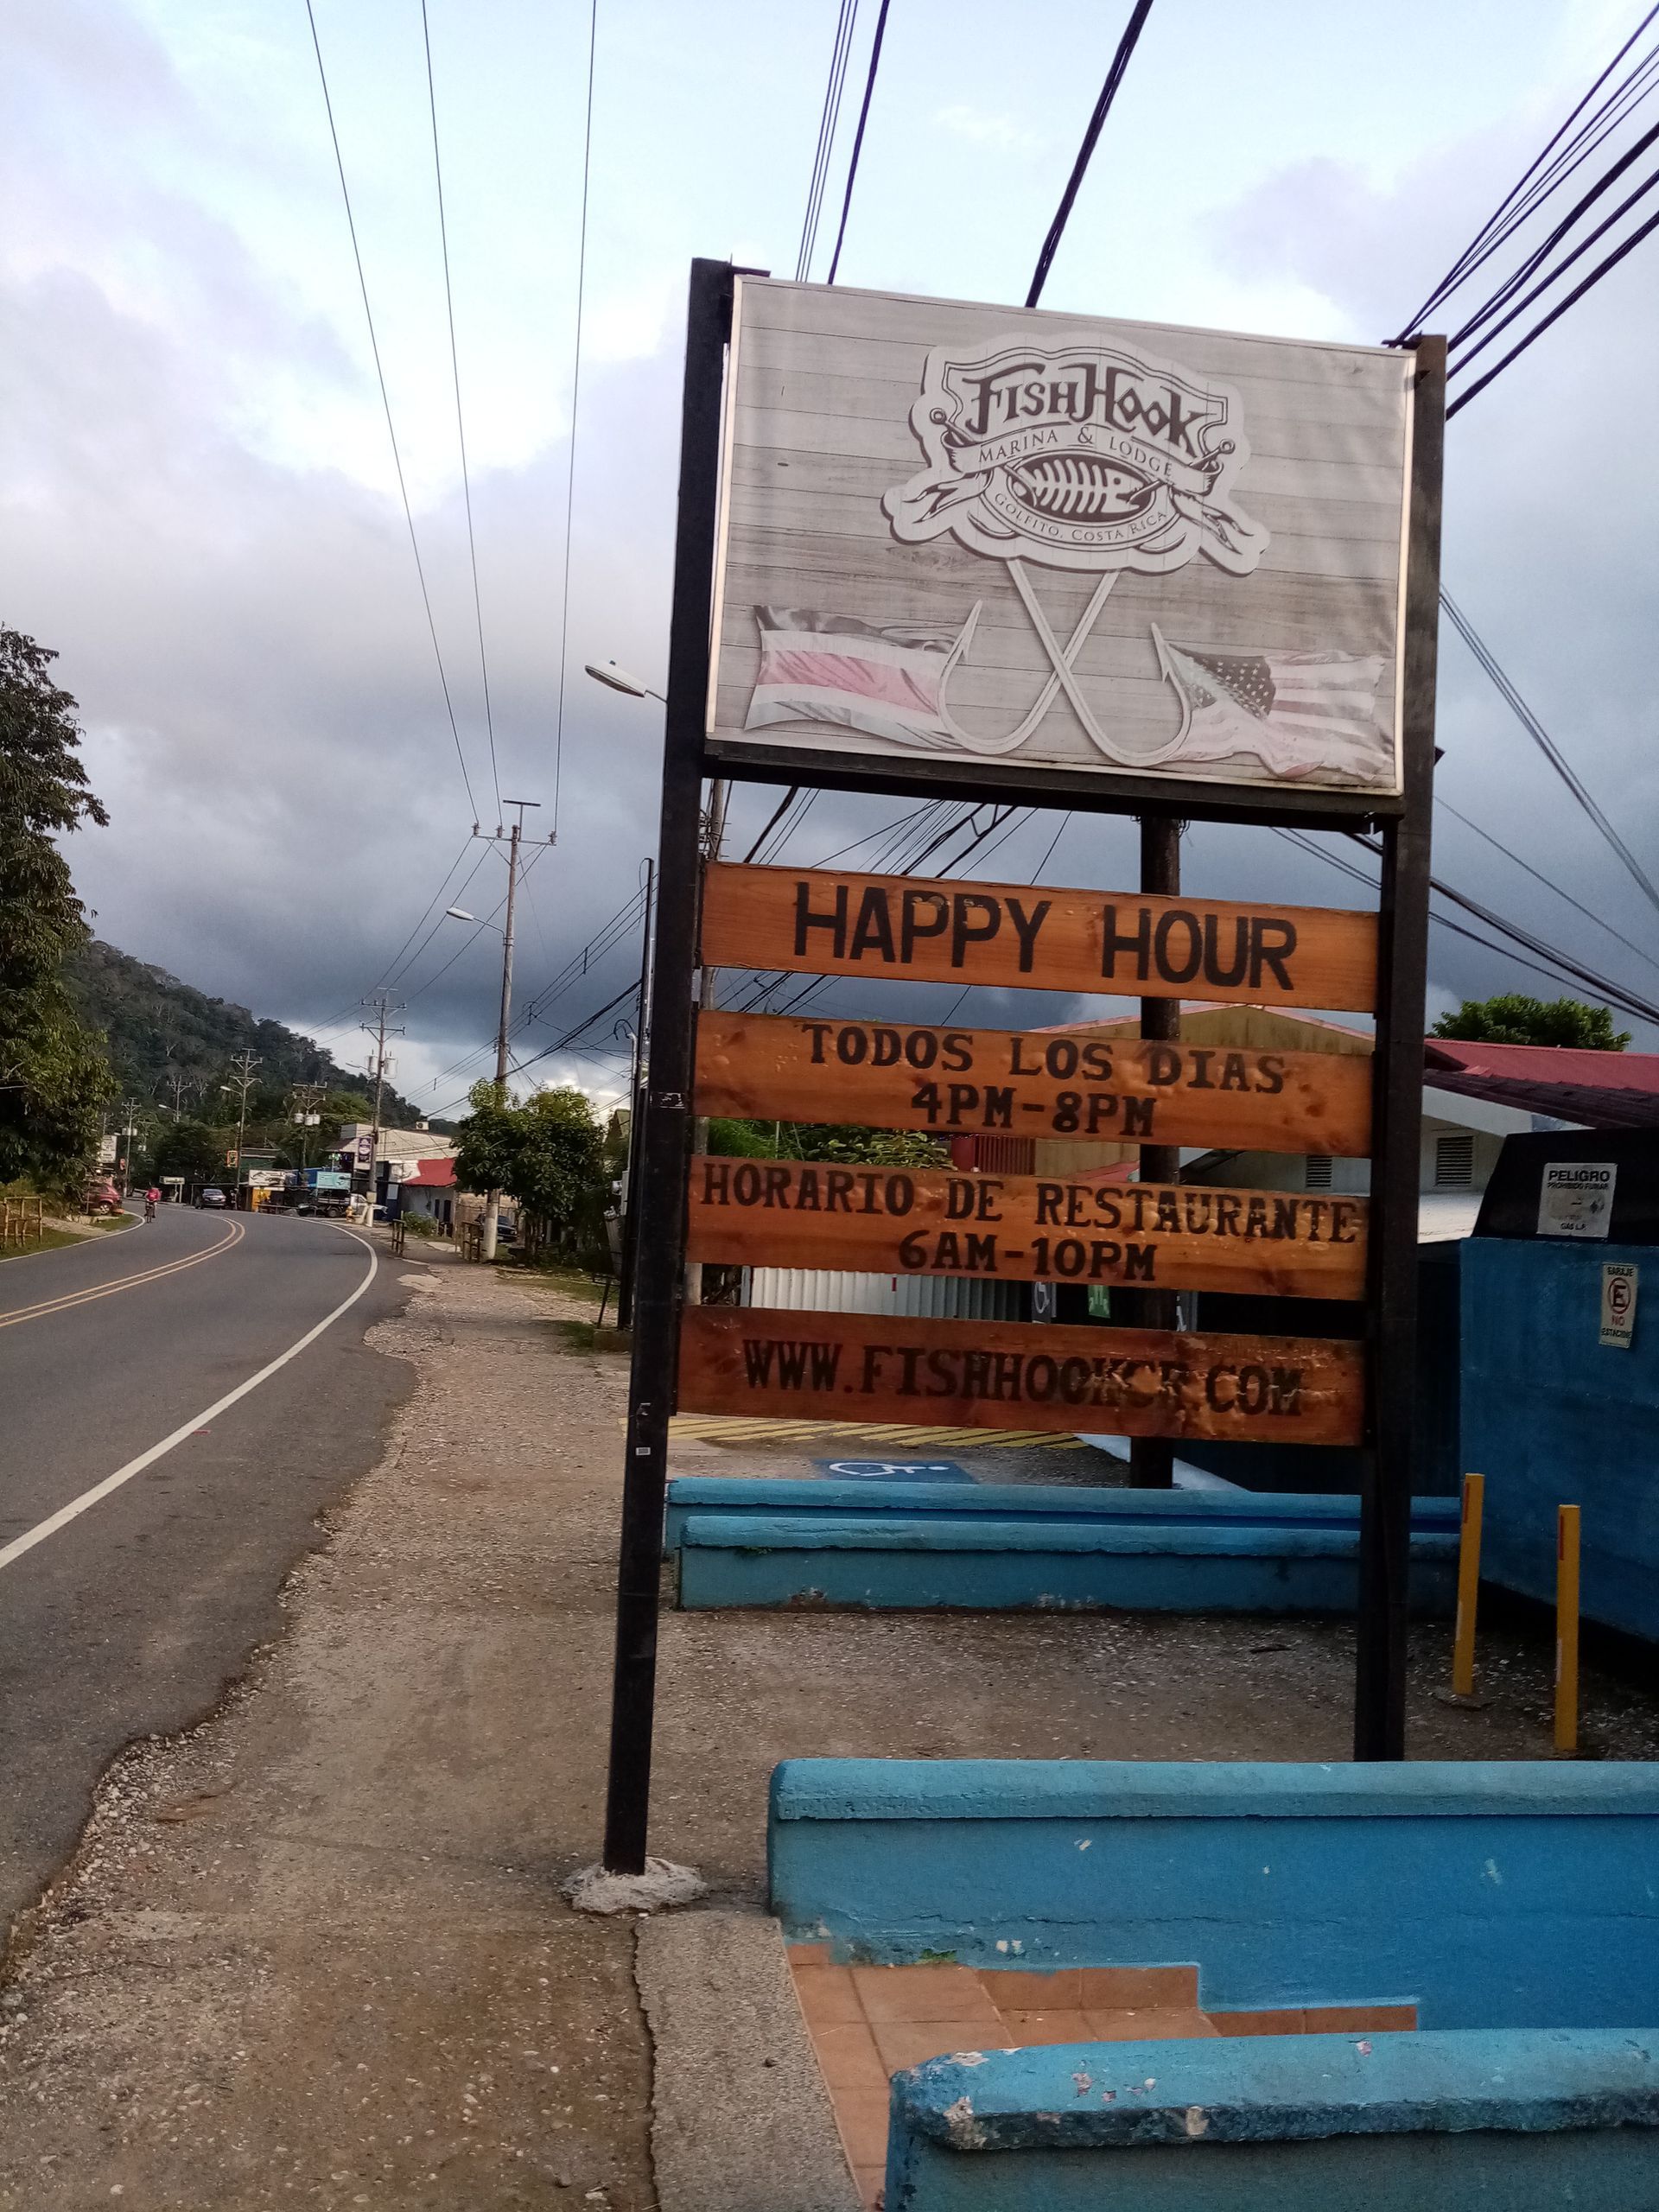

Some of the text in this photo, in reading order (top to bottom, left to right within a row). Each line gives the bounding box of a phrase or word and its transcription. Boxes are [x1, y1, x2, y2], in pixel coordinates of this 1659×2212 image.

[979, 426, 1173, 477] MARINA & LODGE
[1071, 528, 1124, 543] COSTA
[1128, 510, 1167, 535] RICA
[794, 881, 1298, 991] HAPPY HOUR
[801, 1023, 1286, 1096] TODOS LOS DIAS
[911, 1083, 1157, 1138] 4PM-8PM
[700, 1162, 1357, 1244] HORARIO DE RESTAURANTE
[1548, 1170, 1611, 1183] PELIGRO
[898, 1229, 1158, 1282] 6AM-10PM
[1611, 1314, 1625, 1326] NO
